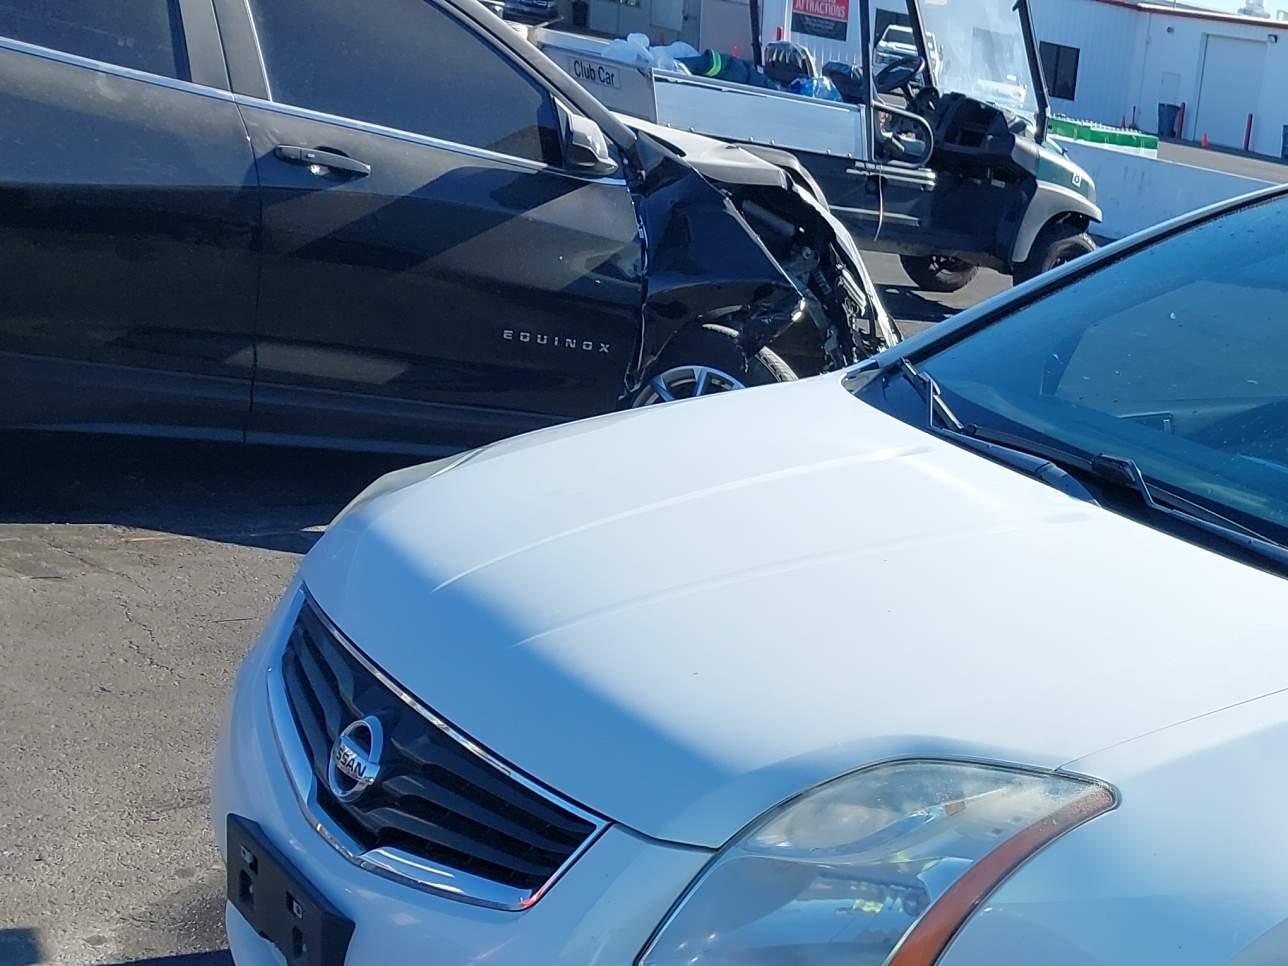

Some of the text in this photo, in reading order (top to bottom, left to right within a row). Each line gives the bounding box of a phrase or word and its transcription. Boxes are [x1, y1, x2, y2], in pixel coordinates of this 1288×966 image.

[573, 60, 615, 87] Club Car
[503, 330, 610, 353] EQUINOX
